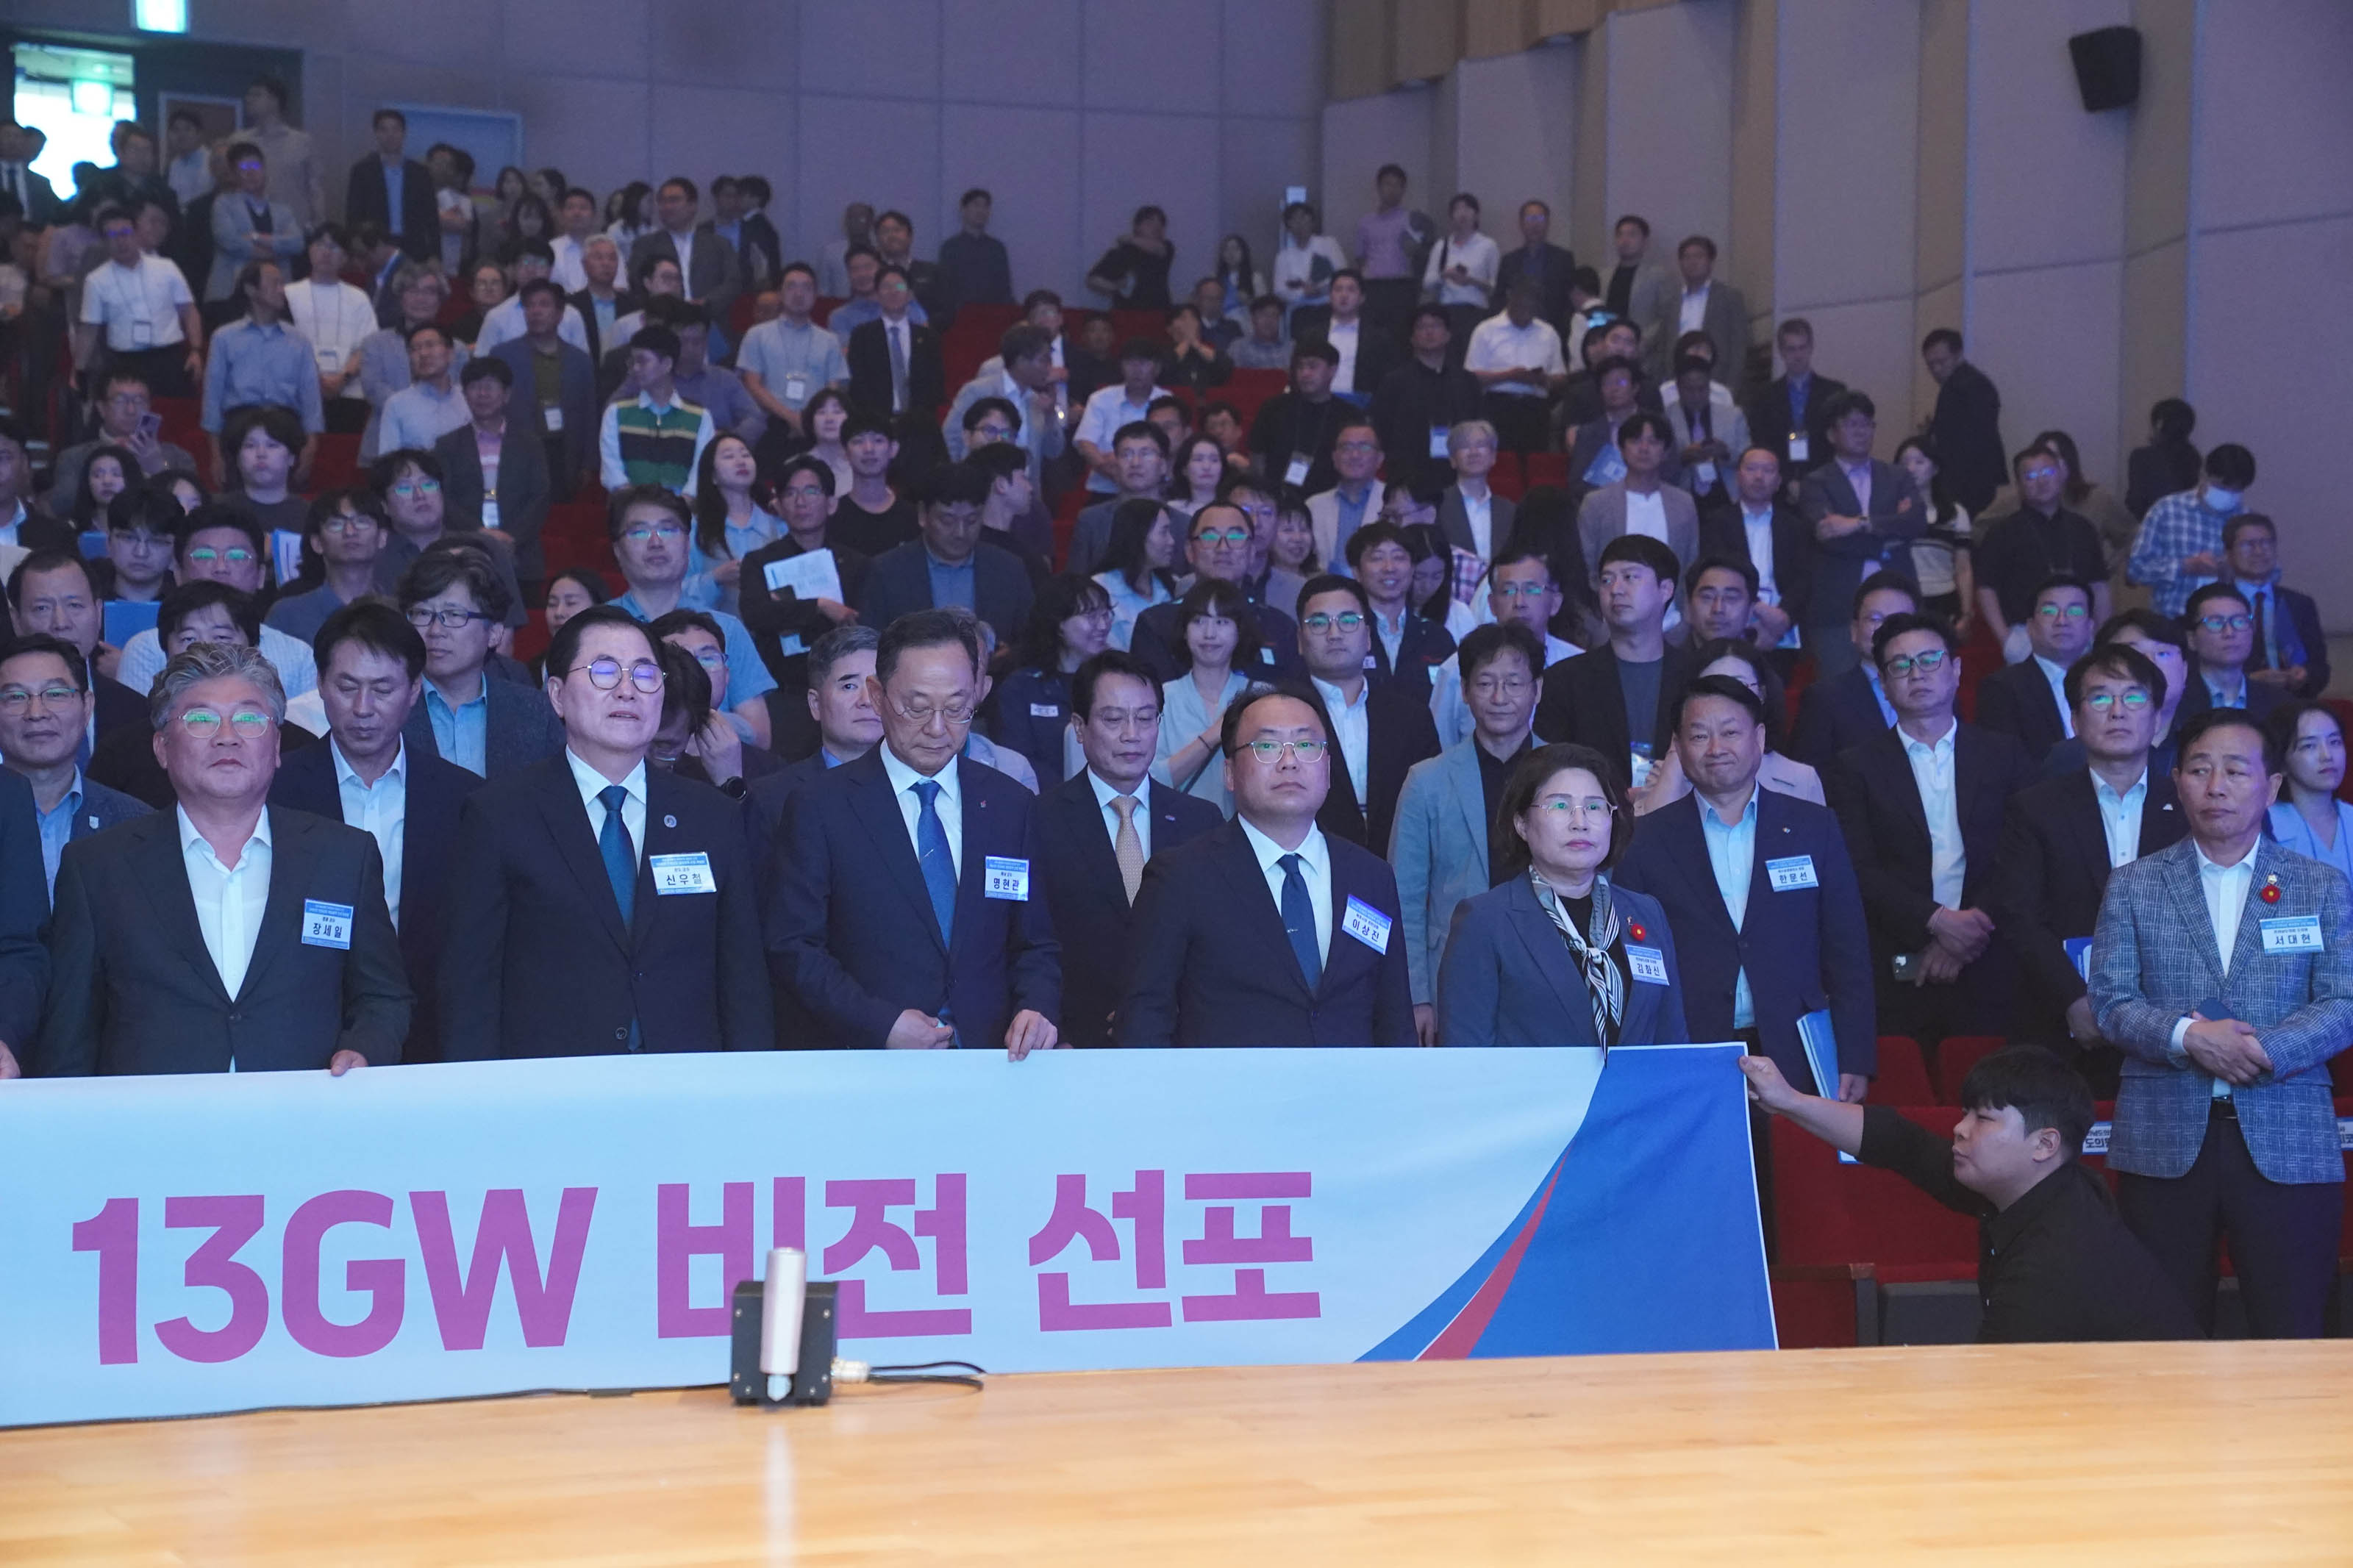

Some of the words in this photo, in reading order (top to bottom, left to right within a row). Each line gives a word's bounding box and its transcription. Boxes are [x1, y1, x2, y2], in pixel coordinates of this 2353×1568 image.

[666, 873, 702, 886] 신우철
[993, 878, 1019, 891] 명현관
[313, 923, 343, 939] 장세일
[1352, 918, 1379, 942] 이상진
[2275, 934, 2311, 945] 서대현
[72, 1187, 599, 1365] 13GW
[657, 1173, 972, 1339] 비전
[1029, 1170, 1321, 1331] 선포
